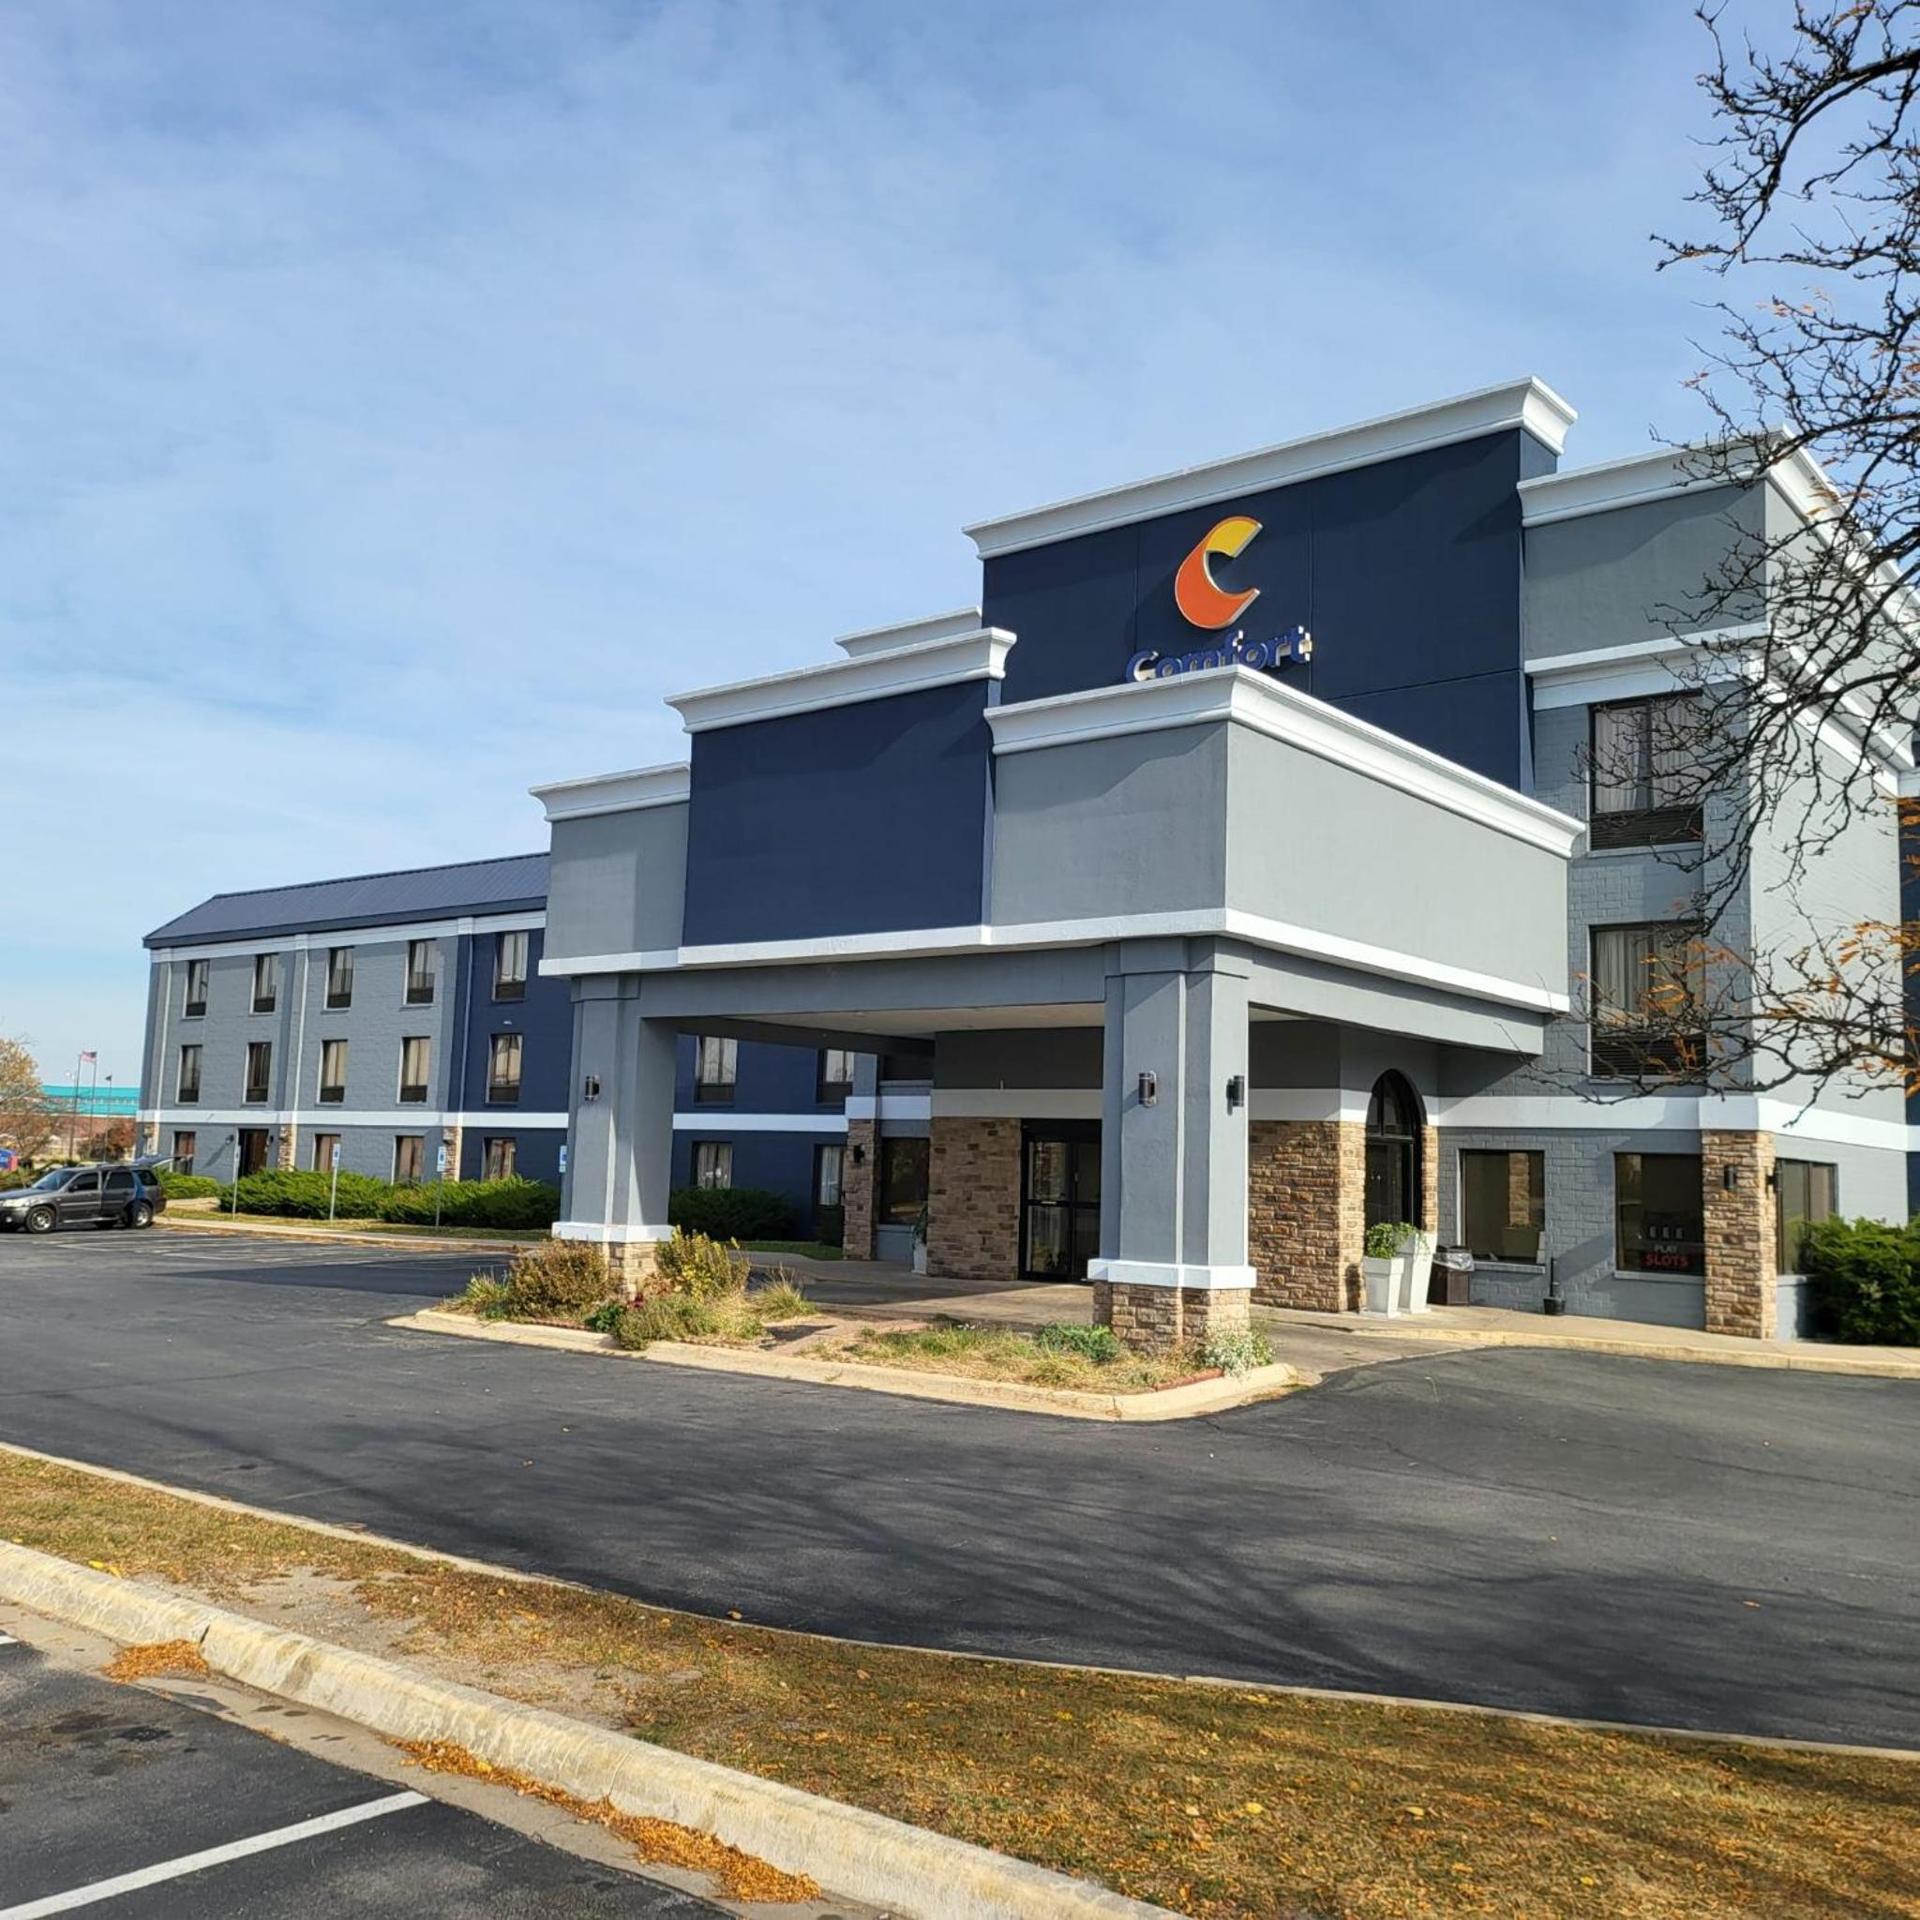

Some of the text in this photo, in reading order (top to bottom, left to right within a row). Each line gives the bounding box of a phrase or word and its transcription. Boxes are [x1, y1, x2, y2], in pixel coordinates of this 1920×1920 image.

[1125, 625, 1313, 684] Comfort
[1654, 1243, 1678, 1254] PLAY
[1644, 1252, 1690, 1268] SLOTS
